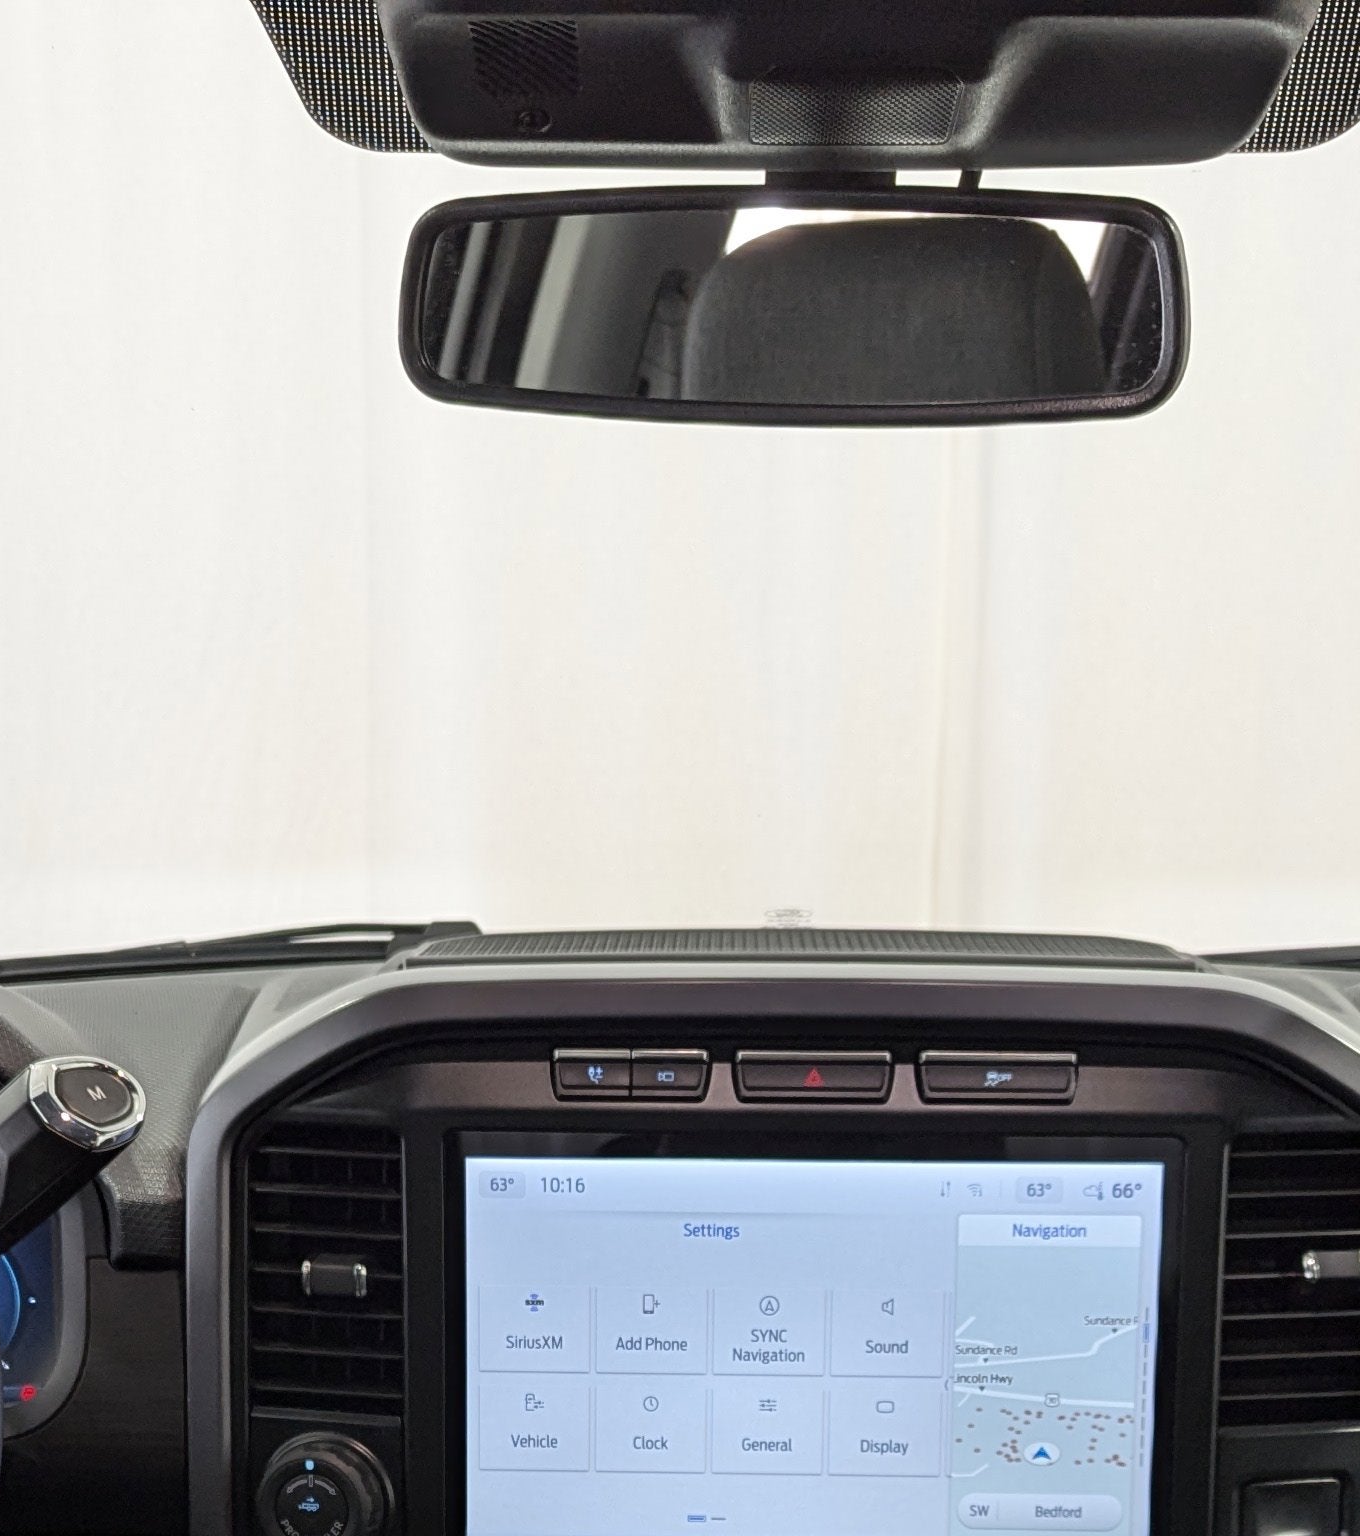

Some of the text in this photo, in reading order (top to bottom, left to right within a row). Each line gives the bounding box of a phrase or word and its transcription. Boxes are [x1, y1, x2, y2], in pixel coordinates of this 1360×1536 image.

[86, 1085, 107, 1101] M
[540, 1176, 586, 1194] 10:16
[683, 1223, 740, 1240] Settings
[1012, 1223, 1087, 1240] Navigation
[1084, 1316, 1131, 1326] Sundance
[505, 1335, 563, 1351] SiriusXM
[750, 1329, 788, 1344] SYNC
[615, 1337, 688, 1352] Add Phone
[865, 1340, 909, 1355] Sound
[955, 1345, 1018, 1355] Sundance Rd
[732, 1348, 805, 1366] Navigation
[990, 1374, 1013, 1386] Hwy
[510, 1434, 558, 1449] Vehicle
[632, 1435, 668, 1451] Clock
[741, 1438, 792, 1453] General
[859, 1439, 909, 1458] Display
[969, 1505, 990, 1518] SW
[1034, 1505, 1082, 1519] Bedford
